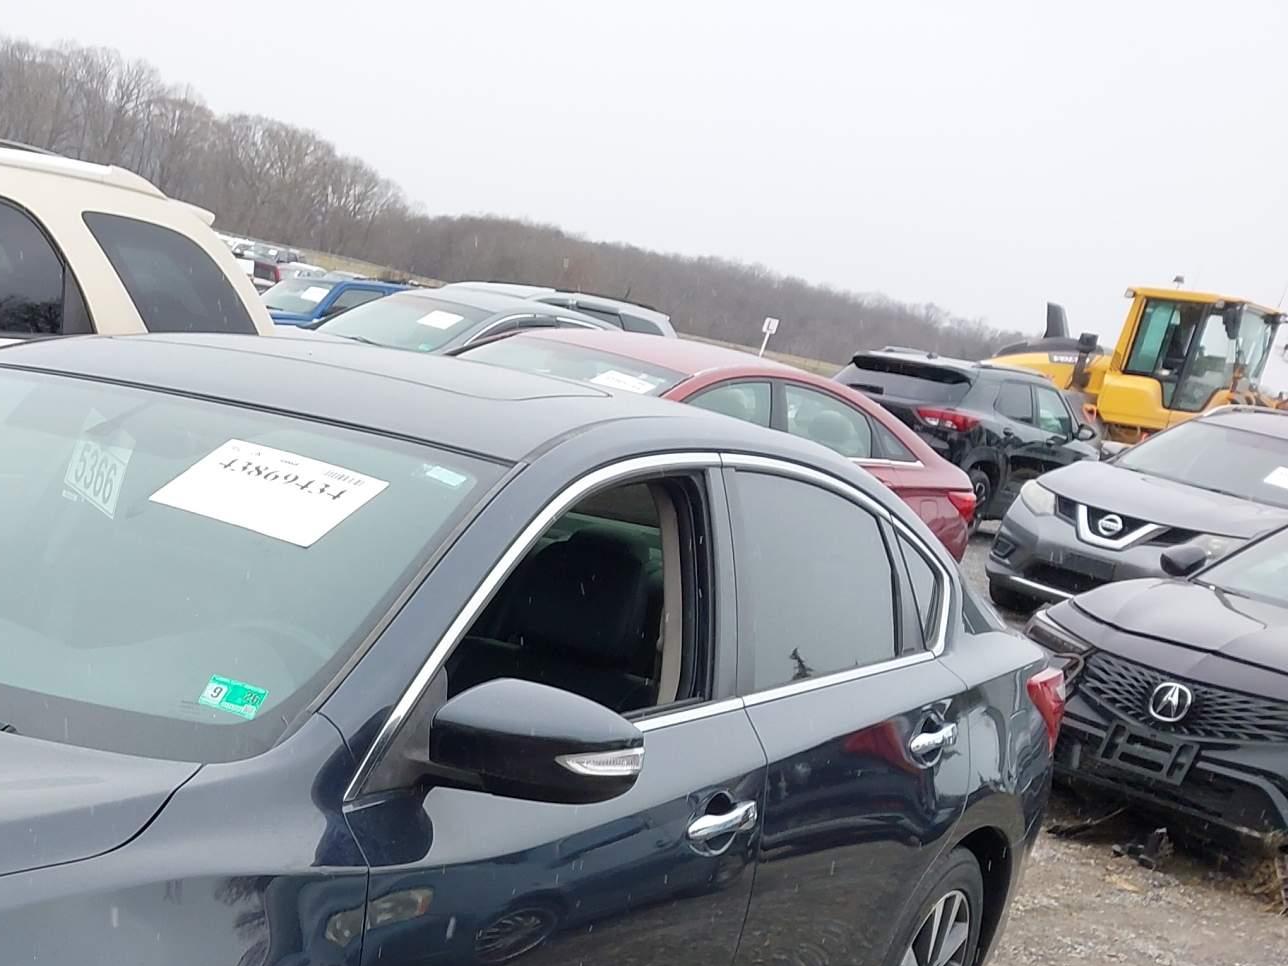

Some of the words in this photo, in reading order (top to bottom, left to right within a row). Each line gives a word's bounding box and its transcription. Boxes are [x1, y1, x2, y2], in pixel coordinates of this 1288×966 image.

[70, 440, 118, 505] 5366
[218, 457, 349, 502] 43869434
[210, 686, 224, 699] 9
